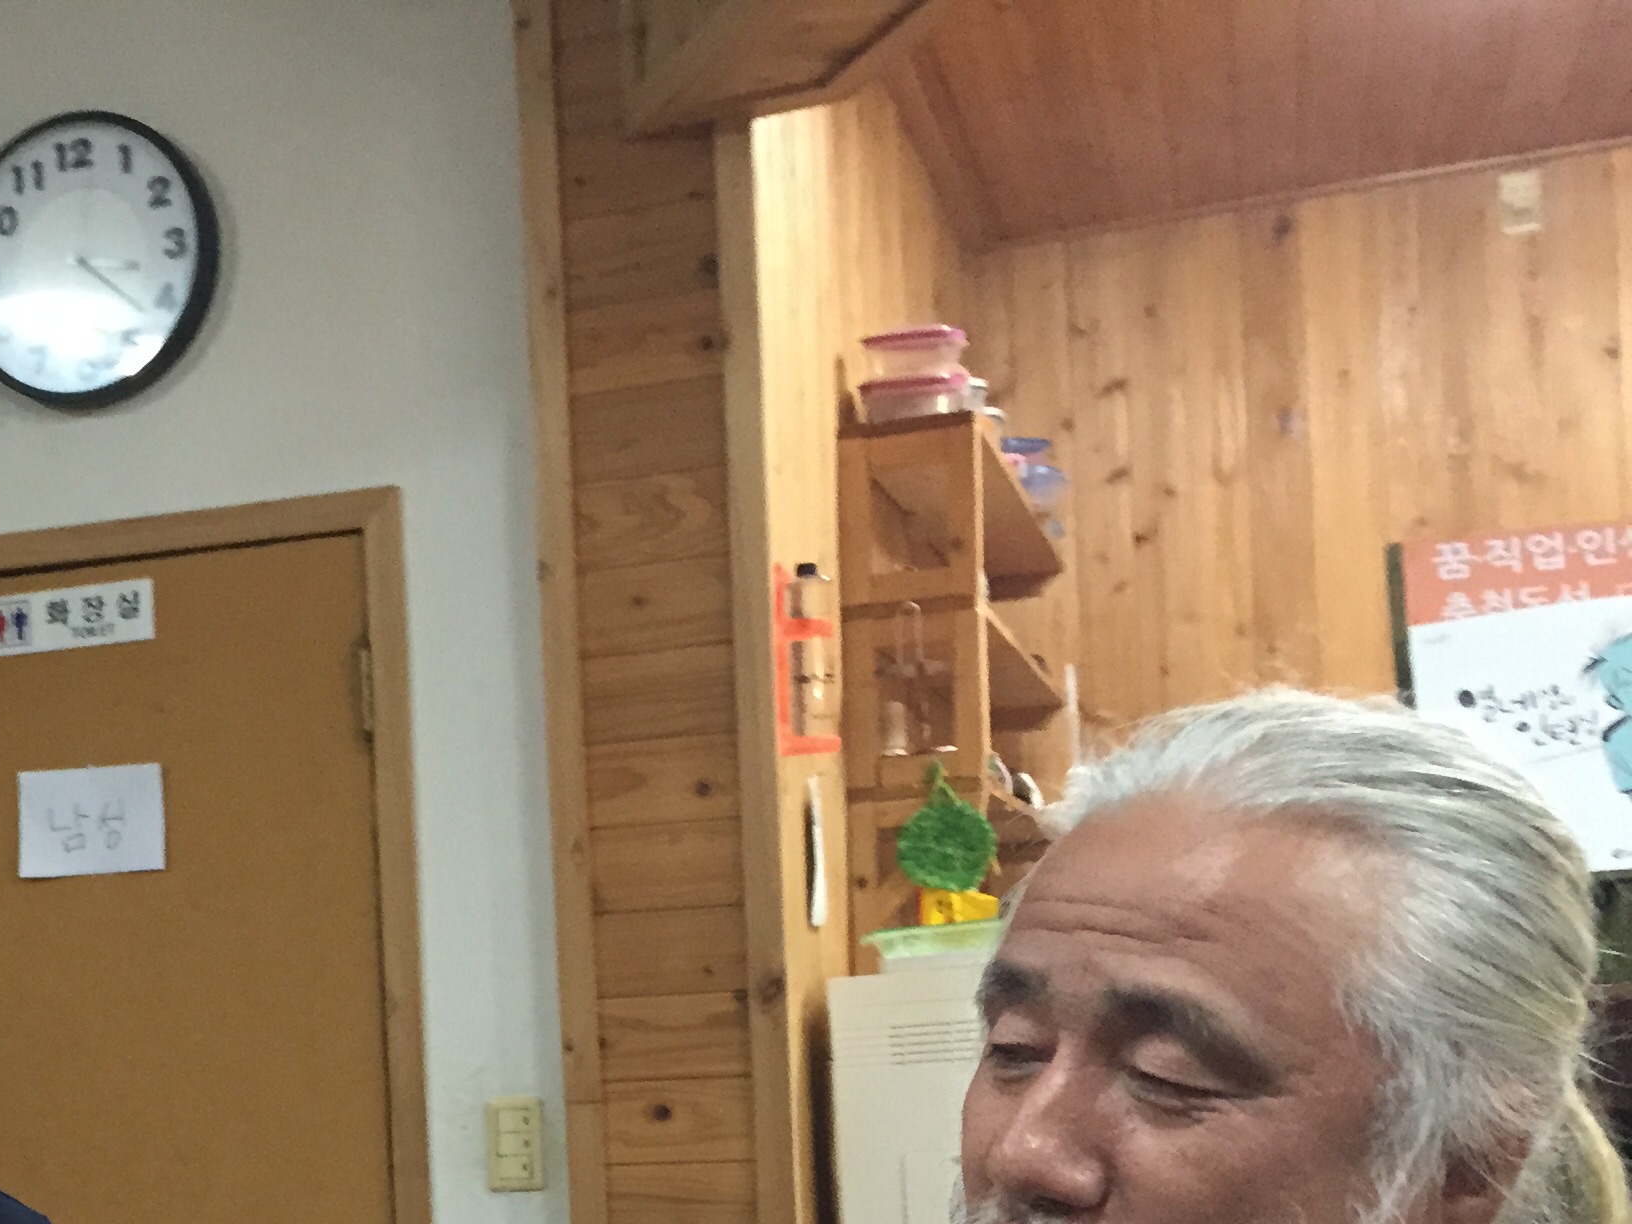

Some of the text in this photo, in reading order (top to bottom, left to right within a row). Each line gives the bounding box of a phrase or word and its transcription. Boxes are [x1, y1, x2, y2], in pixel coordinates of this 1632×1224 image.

[55, 138, 94, 172] 12
[118, 143, 134, 174] 1
[12, 159, 46, 196] 11
[146, 175, 173, 209] 2
[163, 227, 187, 260] 3
